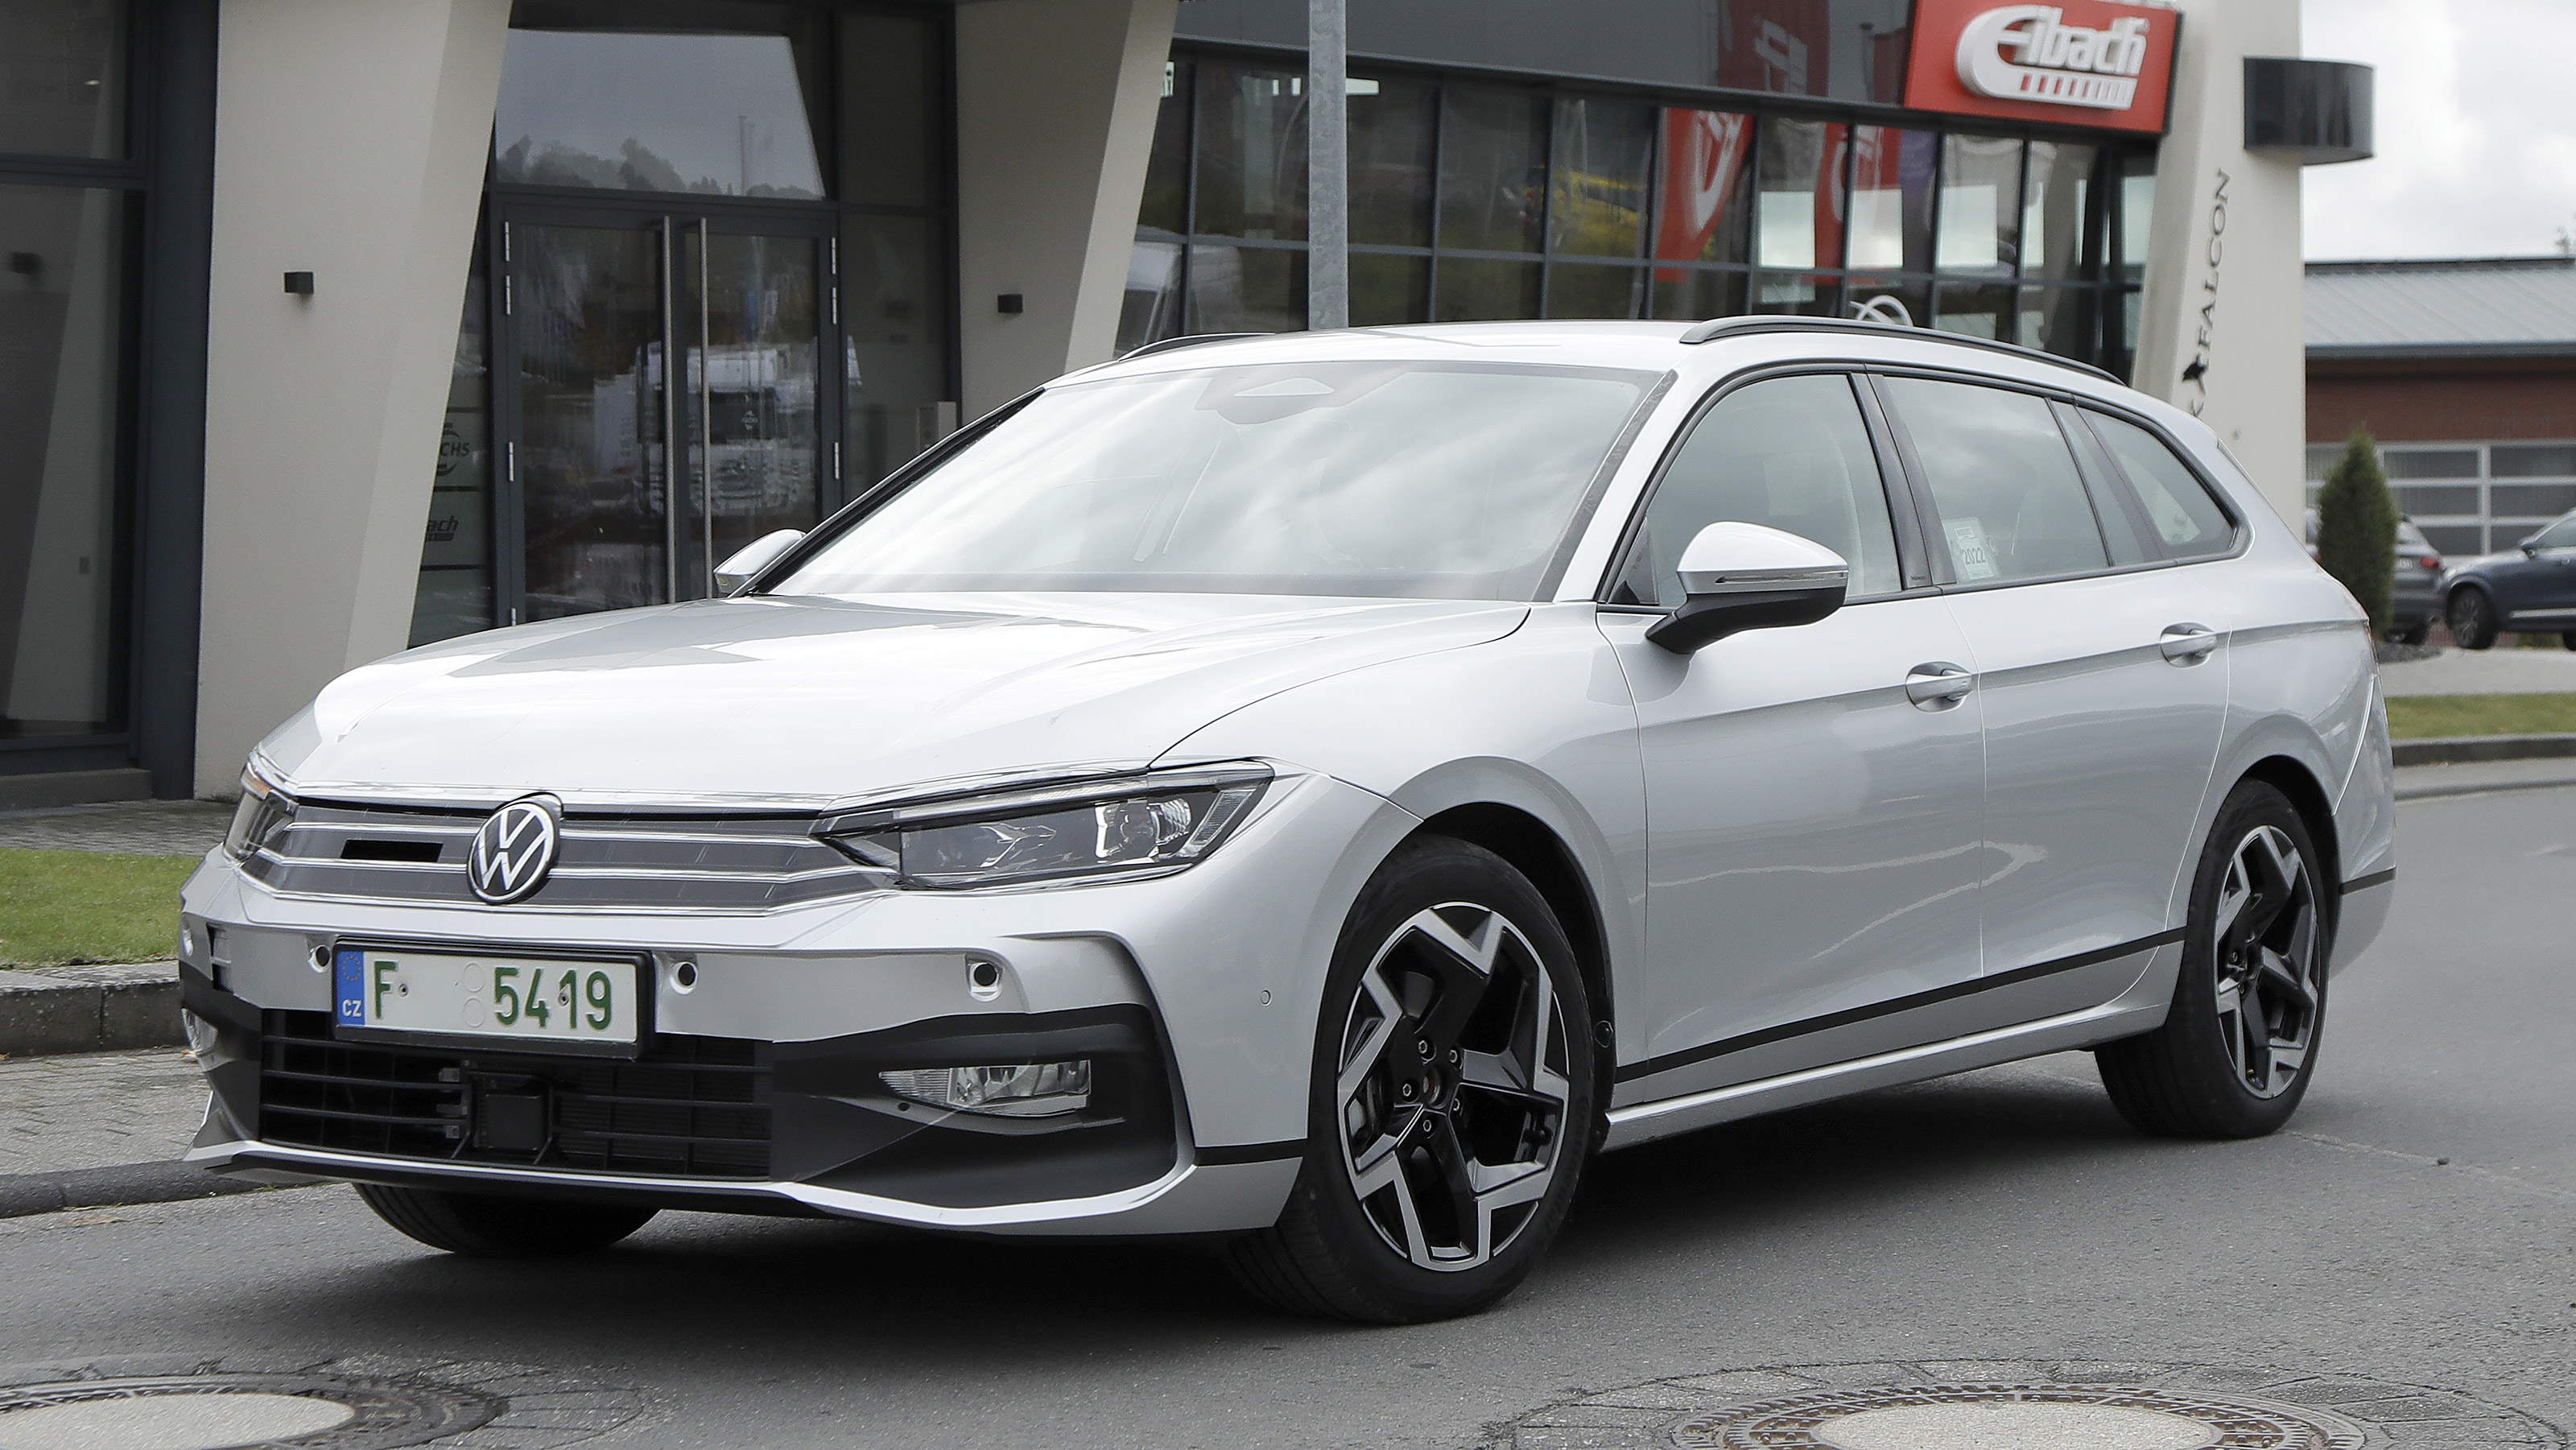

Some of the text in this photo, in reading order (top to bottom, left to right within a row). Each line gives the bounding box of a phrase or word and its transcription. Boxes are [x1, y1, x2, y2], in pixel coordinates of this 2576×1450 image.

[1955, 4, 2150, 110] Eibach
[2197, 167, 2231, 351] FALCON
[440, 442, 470, 456] CHS
[427, 514, 460, 532] ach
[1962, 547, 1987, 565] 2022
[493, 966, 613, 1031] 5419
[342, 999, 362, 1018] CZ
